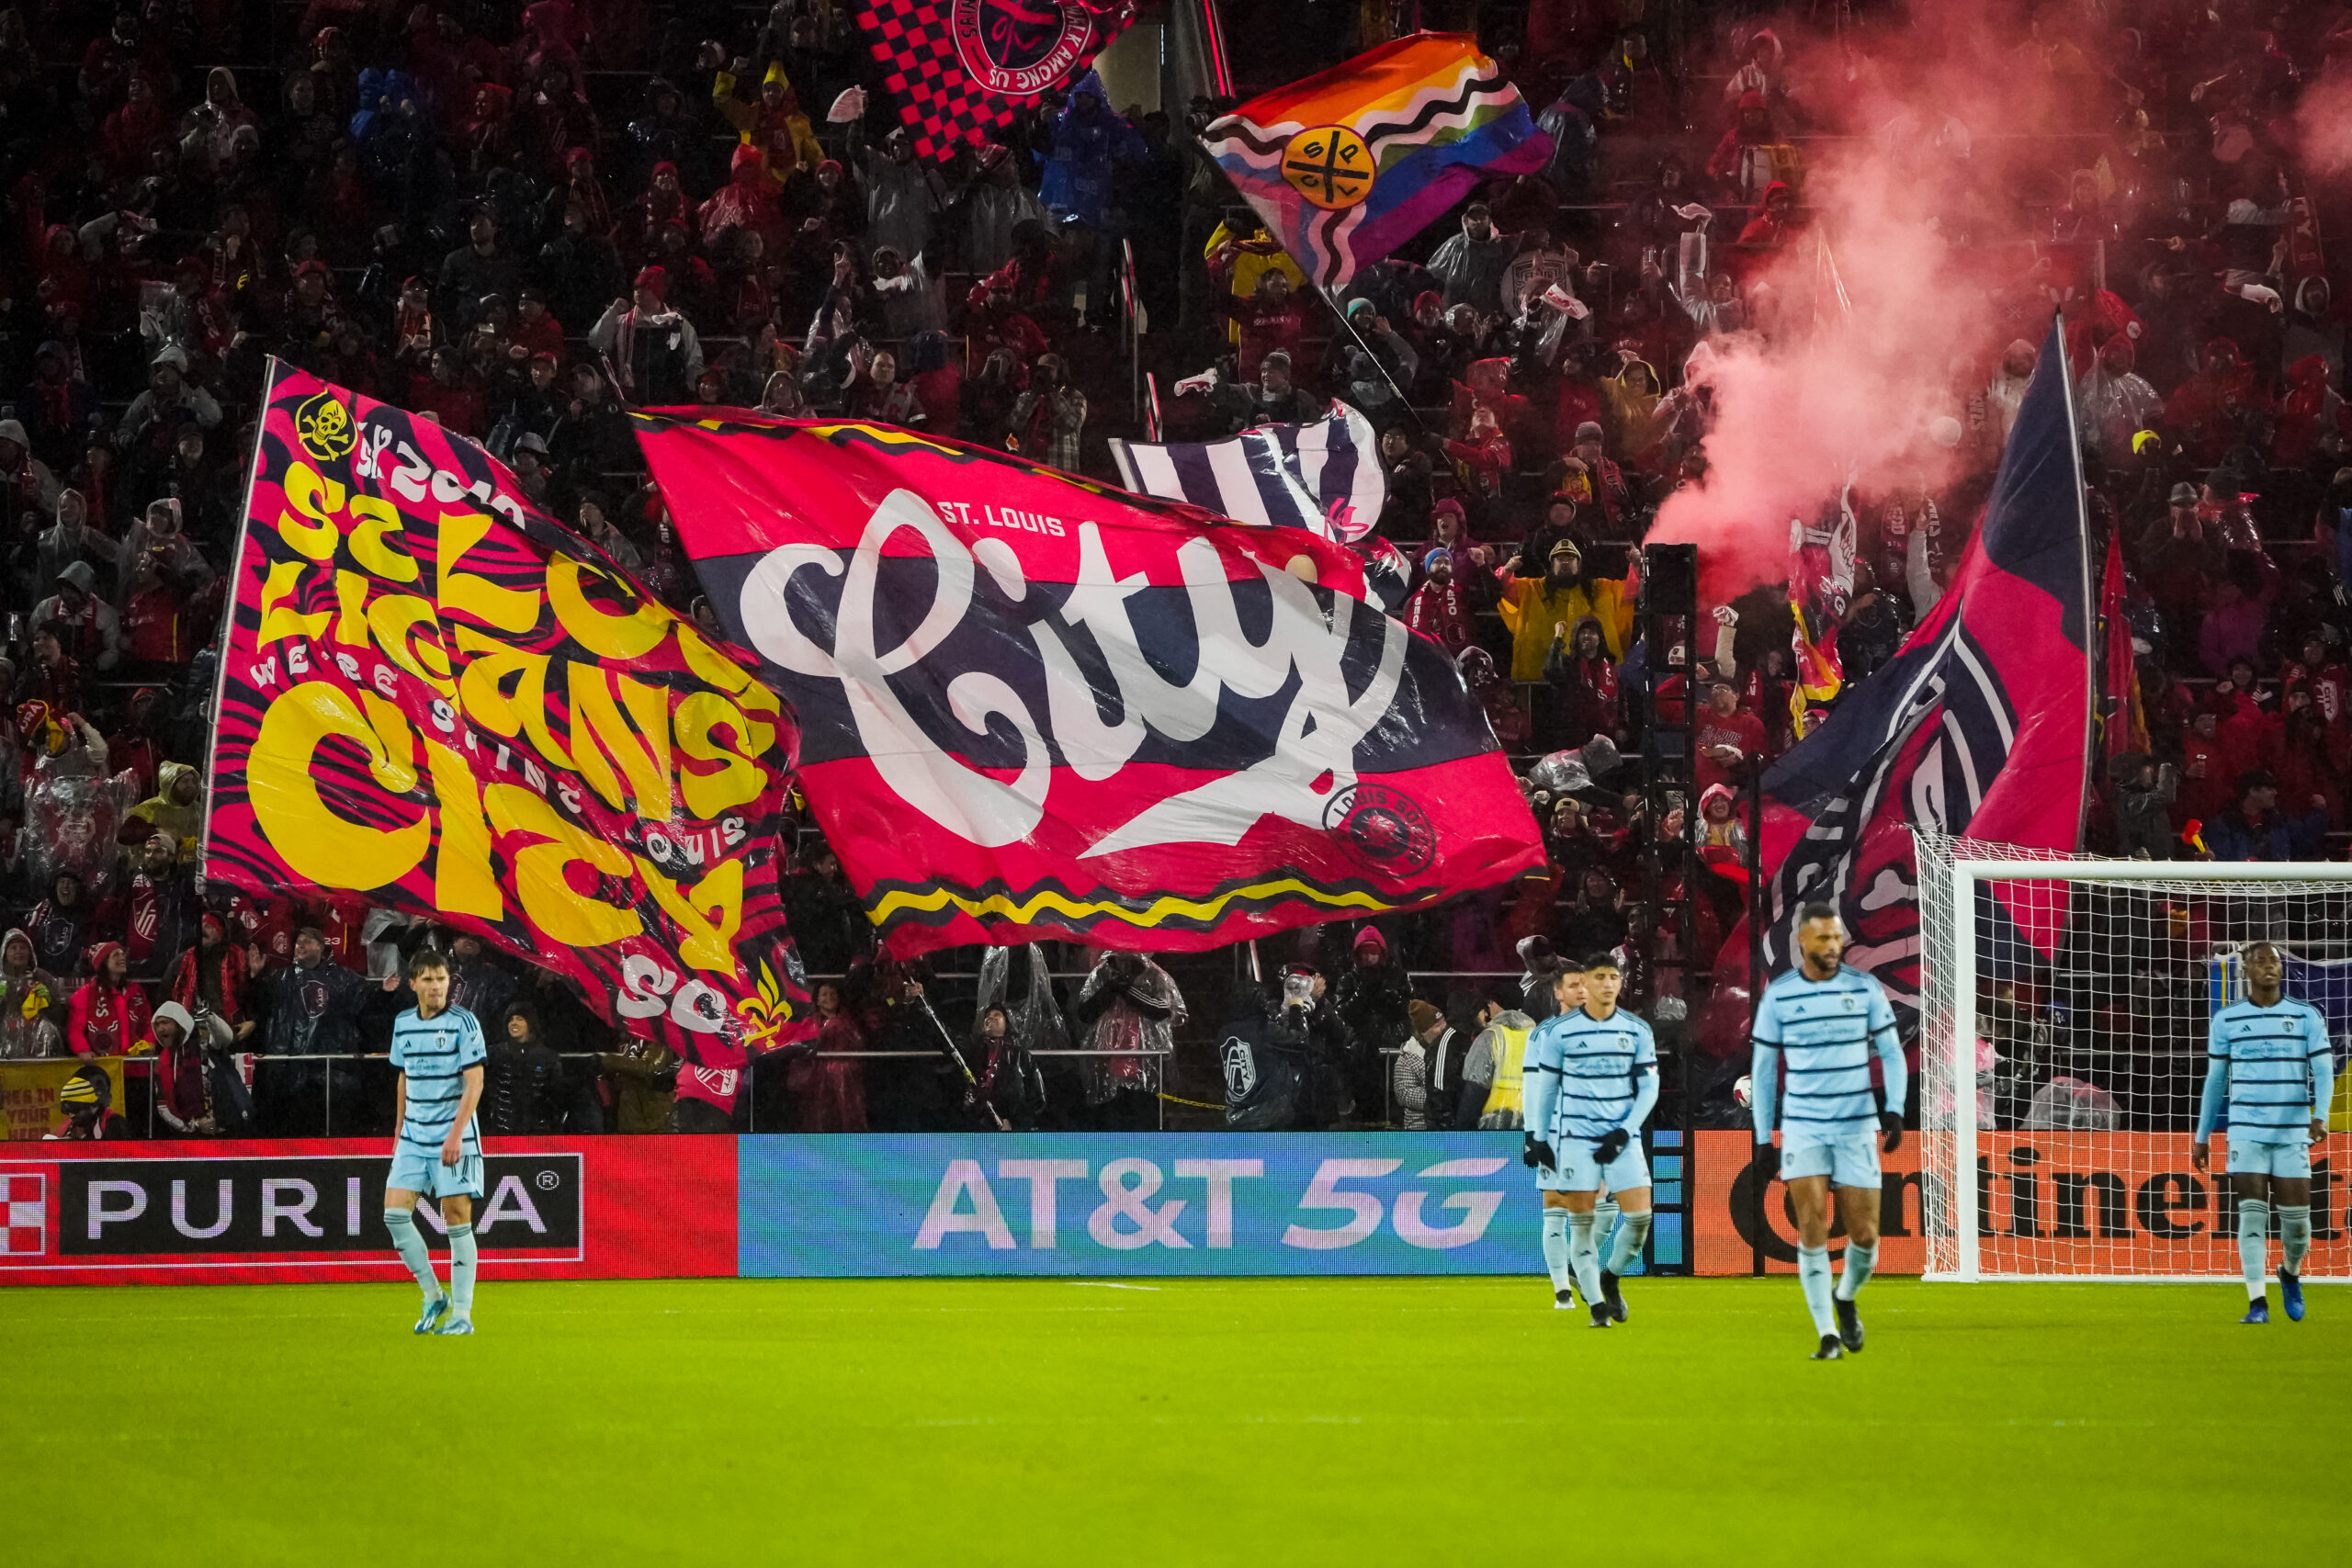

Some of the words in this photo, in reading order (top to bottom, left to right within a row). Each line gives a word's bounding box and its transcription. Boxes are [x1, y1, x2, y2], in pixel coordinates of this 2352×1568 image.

[1064, 6, 1086, 48] WALK
[989, 68, 1010, 88] US
[1016, 46, 1073, 89] AMONG
[937, 502, 979, 525] ST.
[984, 504, 1066, 537] LOUIS
[1412, 596, 1422, 628] BEGI
[1447, 590, 1457, 615] OUR
[741, 489, 1408, 860] City
[2324, 686, 2333, 713] CITY
[1333, 790, 1387, 818] LOUIS
[625, 817, 746, 865] OUIS
[617, 953, 727, 1034] SC
[1238, 1049, 1250, 1080] CITY
[912, 1157, 1264, 1250] AT&T
[1281, 1157, 1510, 1249] 5G
